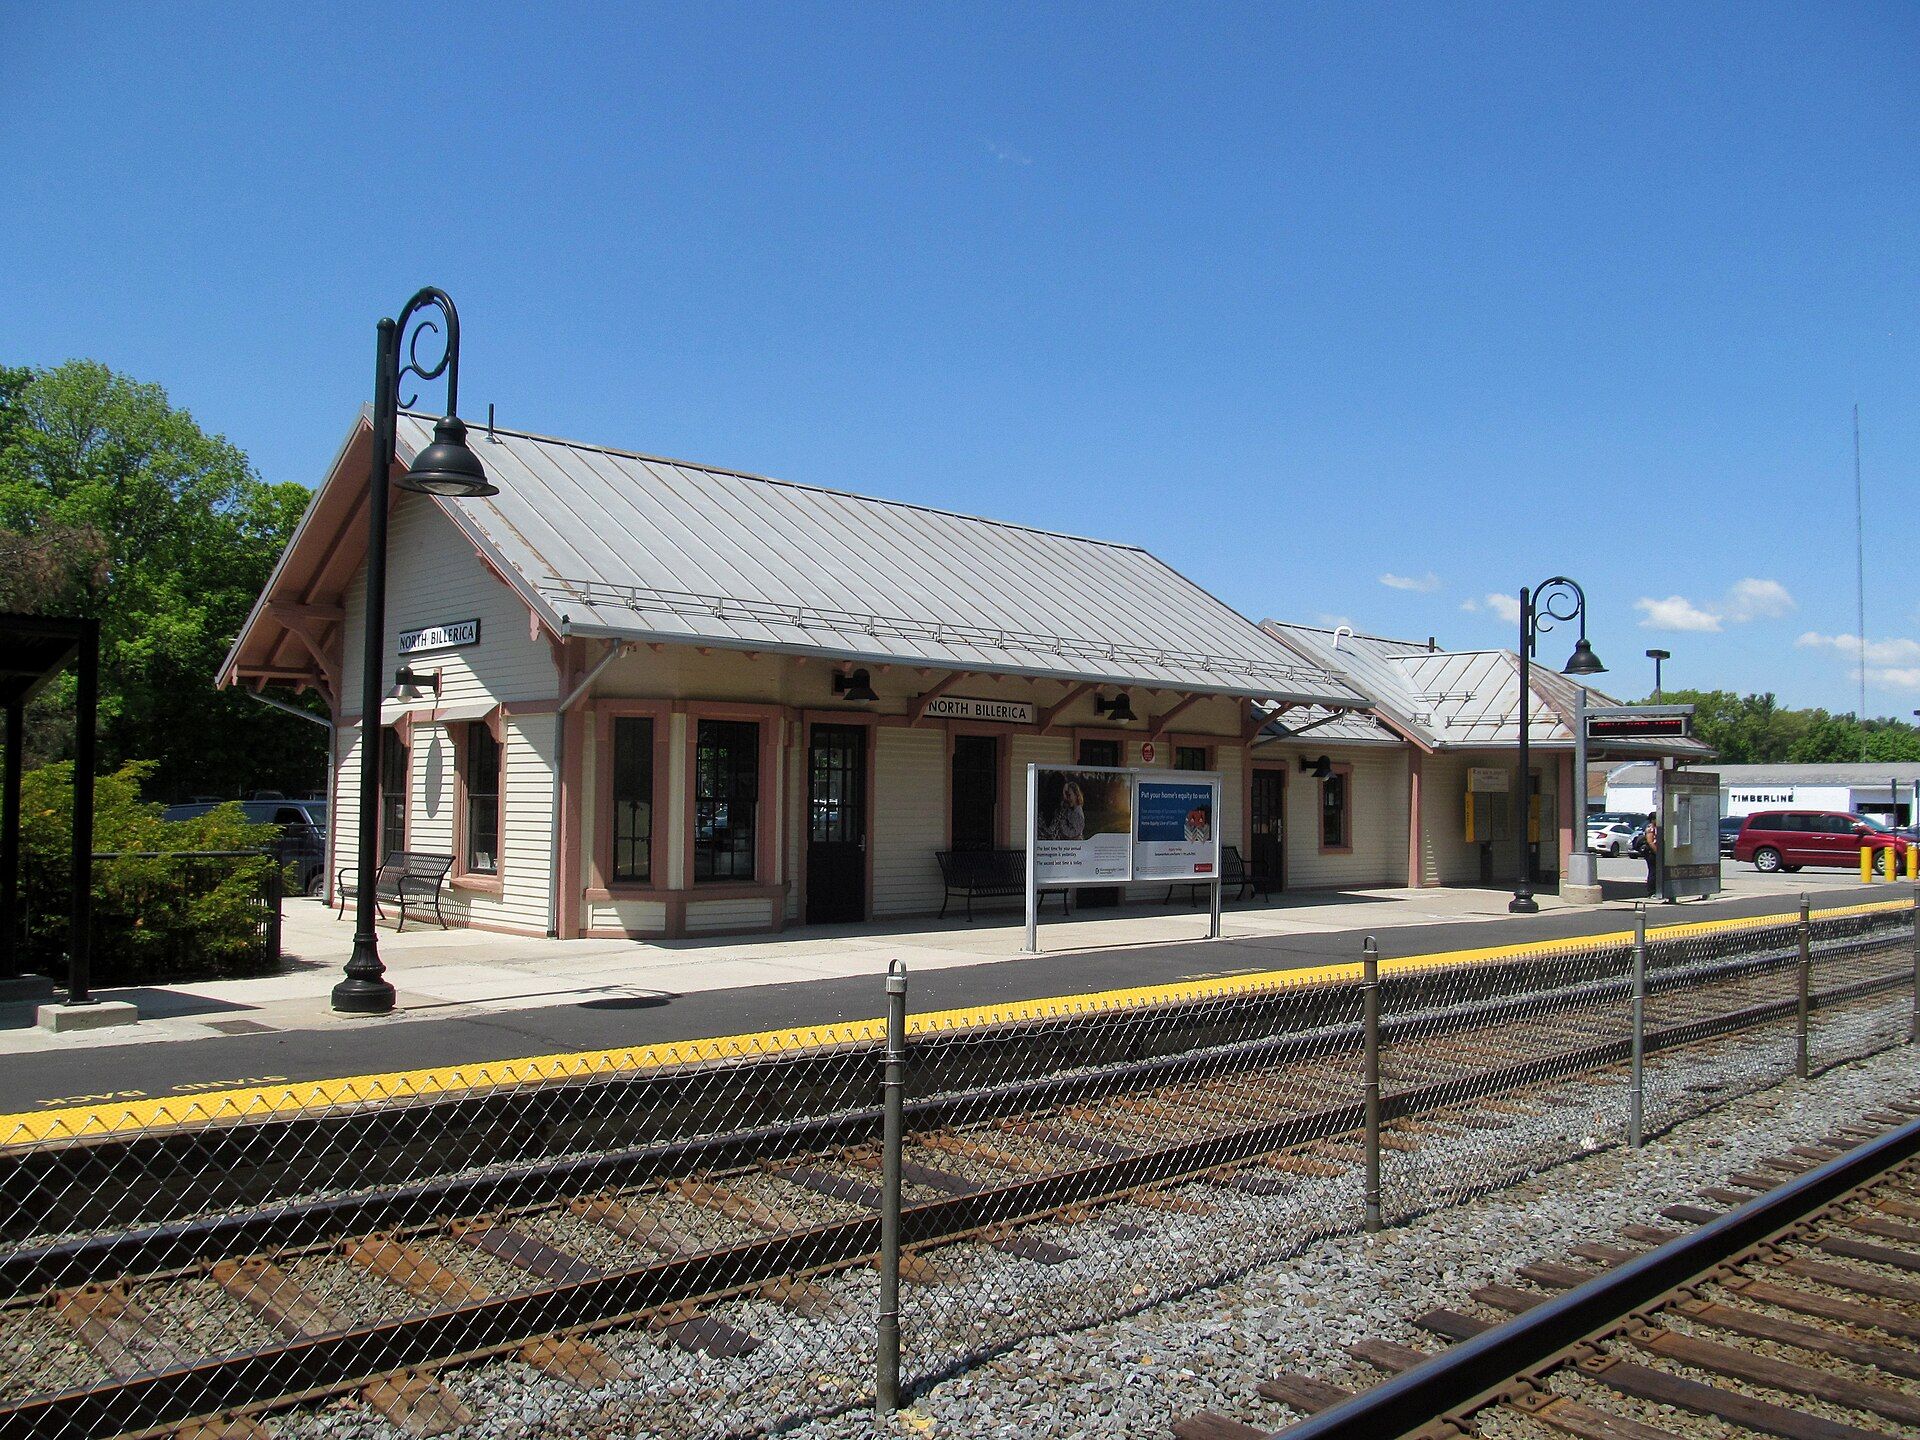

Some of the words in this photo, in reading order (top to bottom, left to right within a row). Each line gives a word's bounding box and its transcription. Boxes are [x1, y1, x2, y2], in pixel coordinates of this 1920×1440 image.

[399, 633, 427, 650] NORTH
[431, 626, 474, 644] BILLERICA
[928, 700, 969, 715] NORTH
[975, 704, 1027, 719] BILLERICA
[1150, 792, 1161, 800] your
[1161, 791, 1178, 799] home's
[1178, 792, 1192, 801] equity
[1731, 794, 1794, 803] TIMBERLINE
[171, 1075, 288, 1091] STAND
[35, 1089, 148, 1107] BACK
